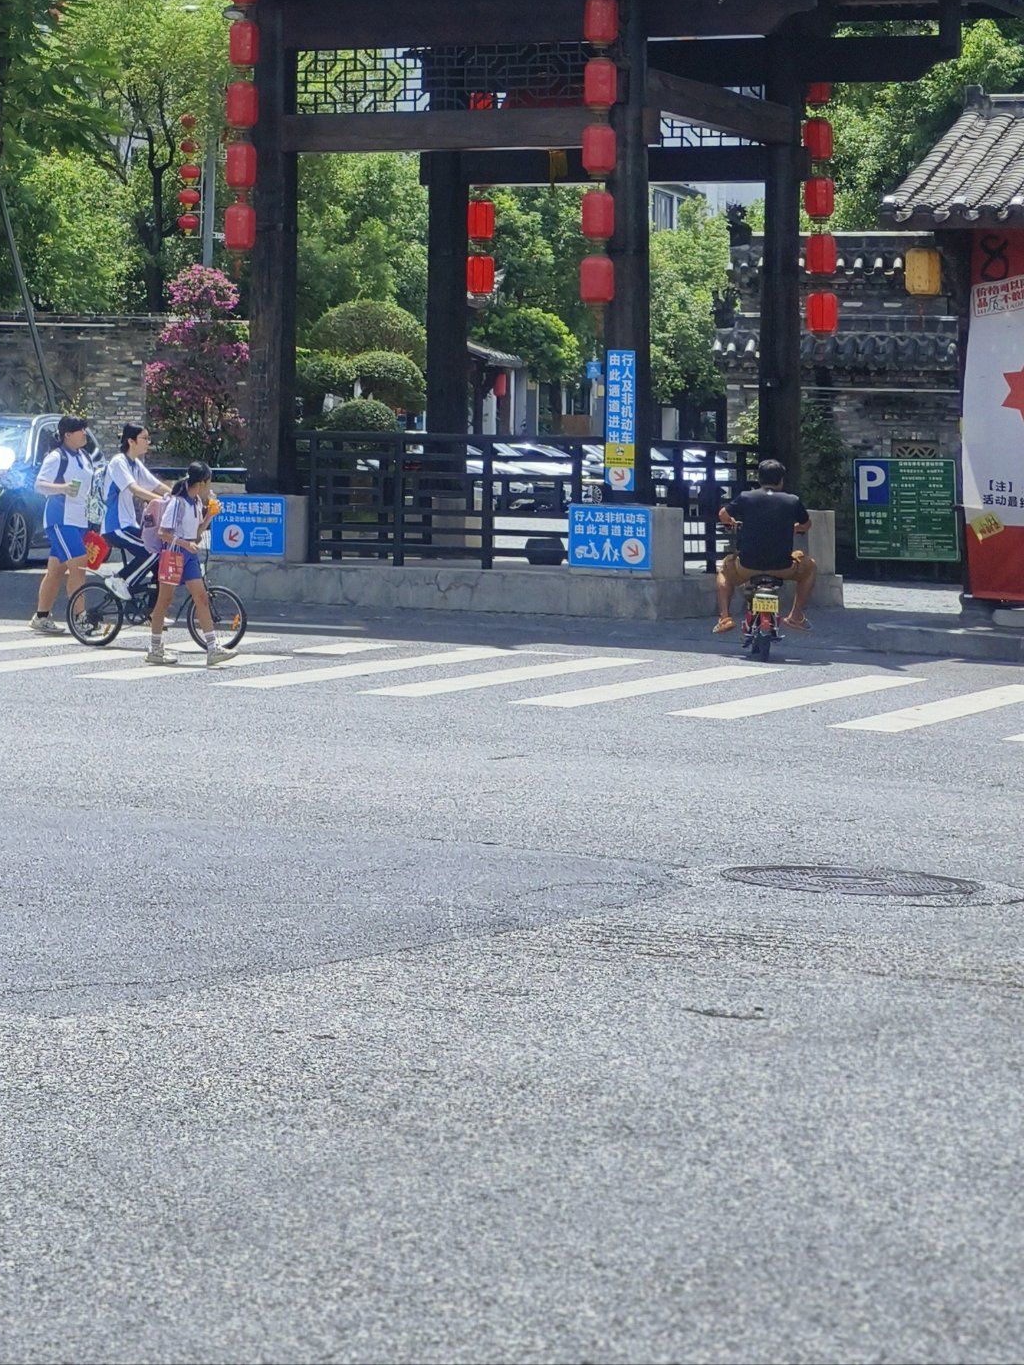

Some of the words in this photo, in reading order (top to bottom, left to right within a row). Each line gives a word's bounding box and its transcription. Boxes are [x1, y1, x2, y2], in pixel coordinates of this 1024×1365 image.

[607, 354, 620, 444] 由此通道进出
[621, 354, 633, 444] 行人及非机动车
[858, 465, 886, 500] P
[574, 511, 646, 524] 行人及非机动车
[574, 524, 646, 538] 由此通道进出
